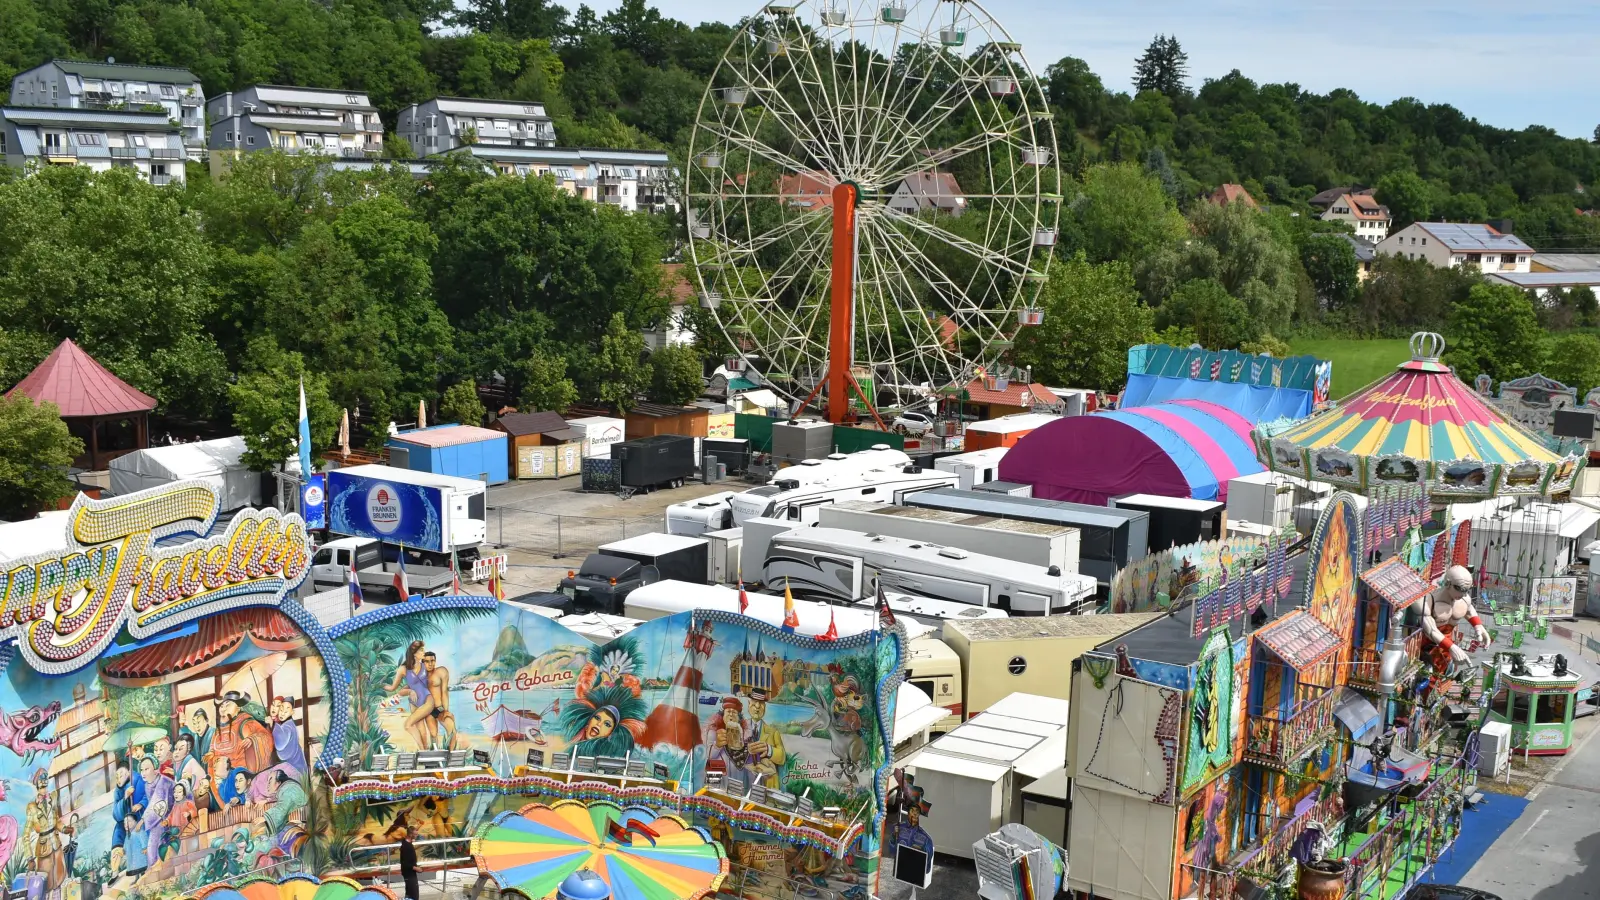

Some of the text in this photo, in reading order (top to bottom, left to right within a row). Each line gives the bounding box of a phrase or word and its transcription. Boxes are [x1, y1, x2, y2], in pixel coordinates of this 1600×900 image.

[0, 487, 307, 662] APPY Traveller
[473, 670, 573, 702] Copa Cabana
